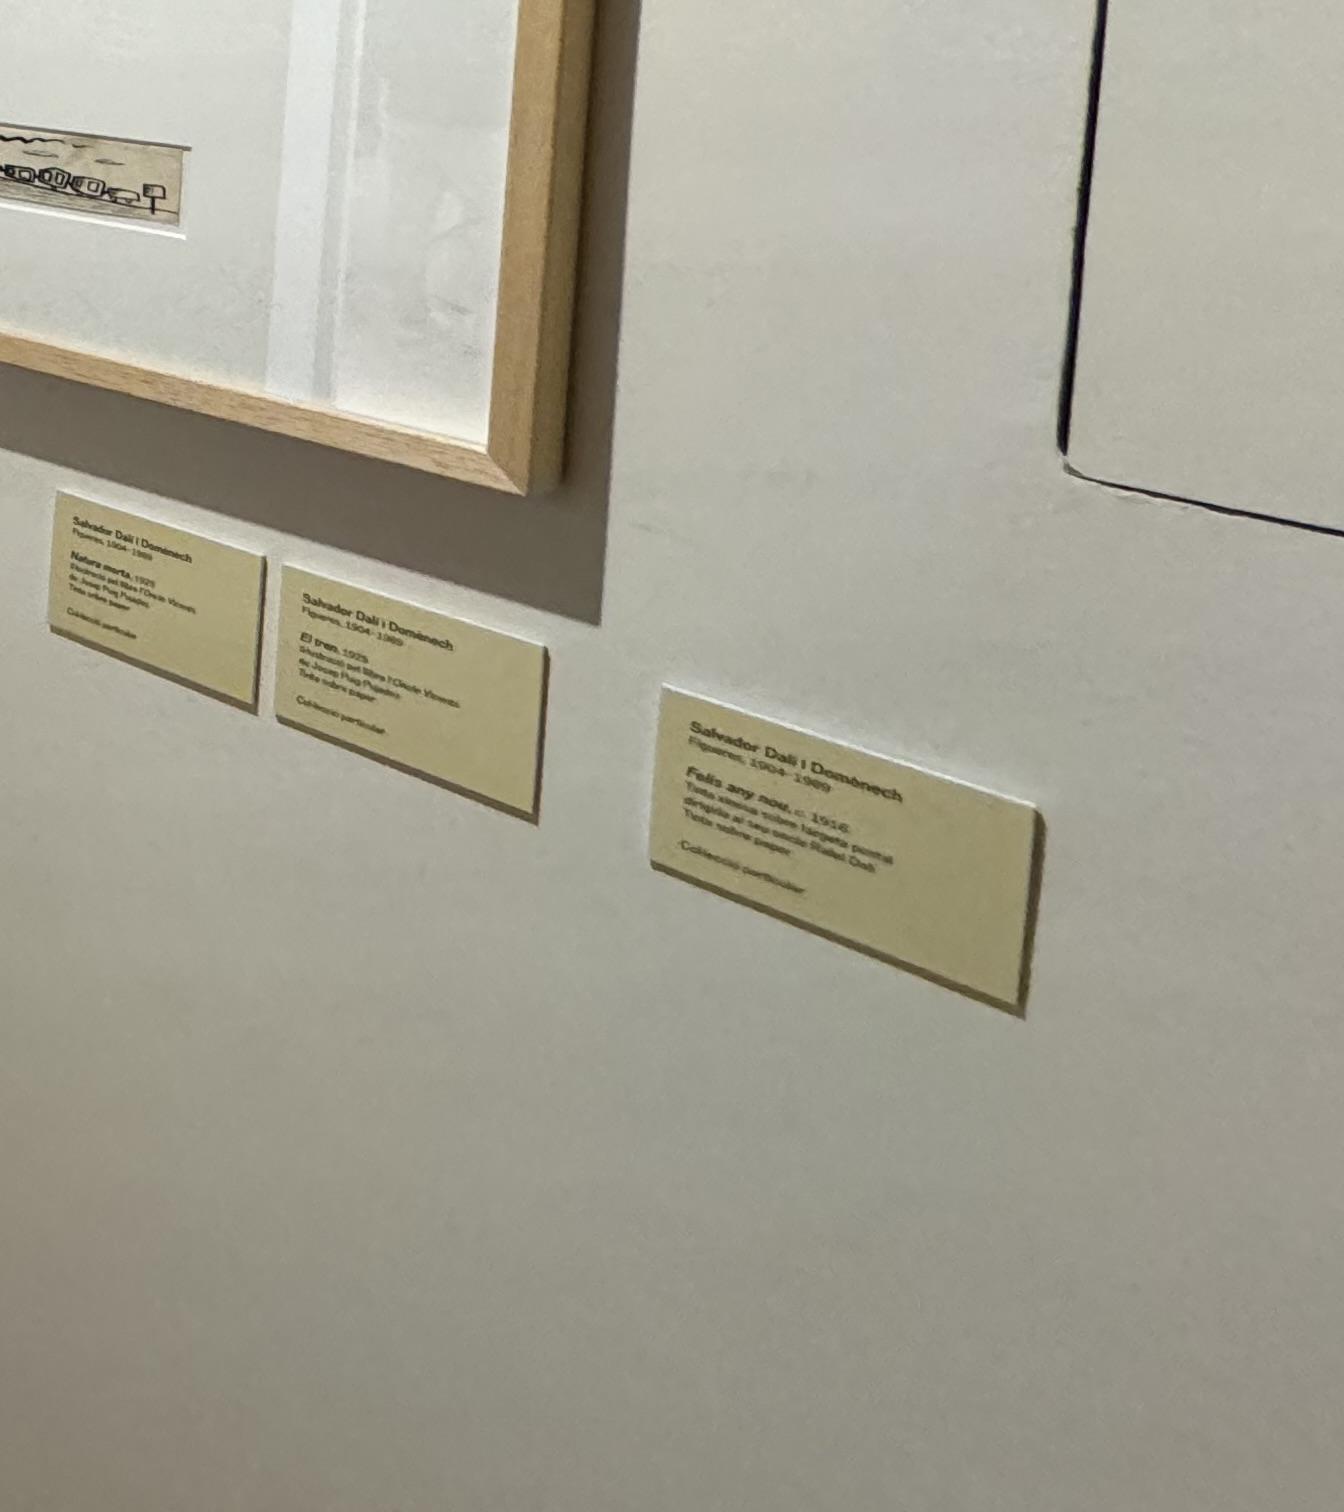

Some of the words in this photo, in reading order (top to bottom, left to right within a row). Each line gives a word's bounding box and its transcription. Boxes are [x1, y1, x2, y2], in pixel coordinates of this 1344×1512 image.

[73, 516, 113, 536] Salvador
[71, 550, 102, 568] Natura
[303, 593, 352, 617] Salvador
[300, 632, 312, 644] El
[690, 721, 759, 752] Salvador
[811, 761, 903, 803] Domènech
[726, 784, 754, 800] any
[761, 811, 797, 831] sobre
